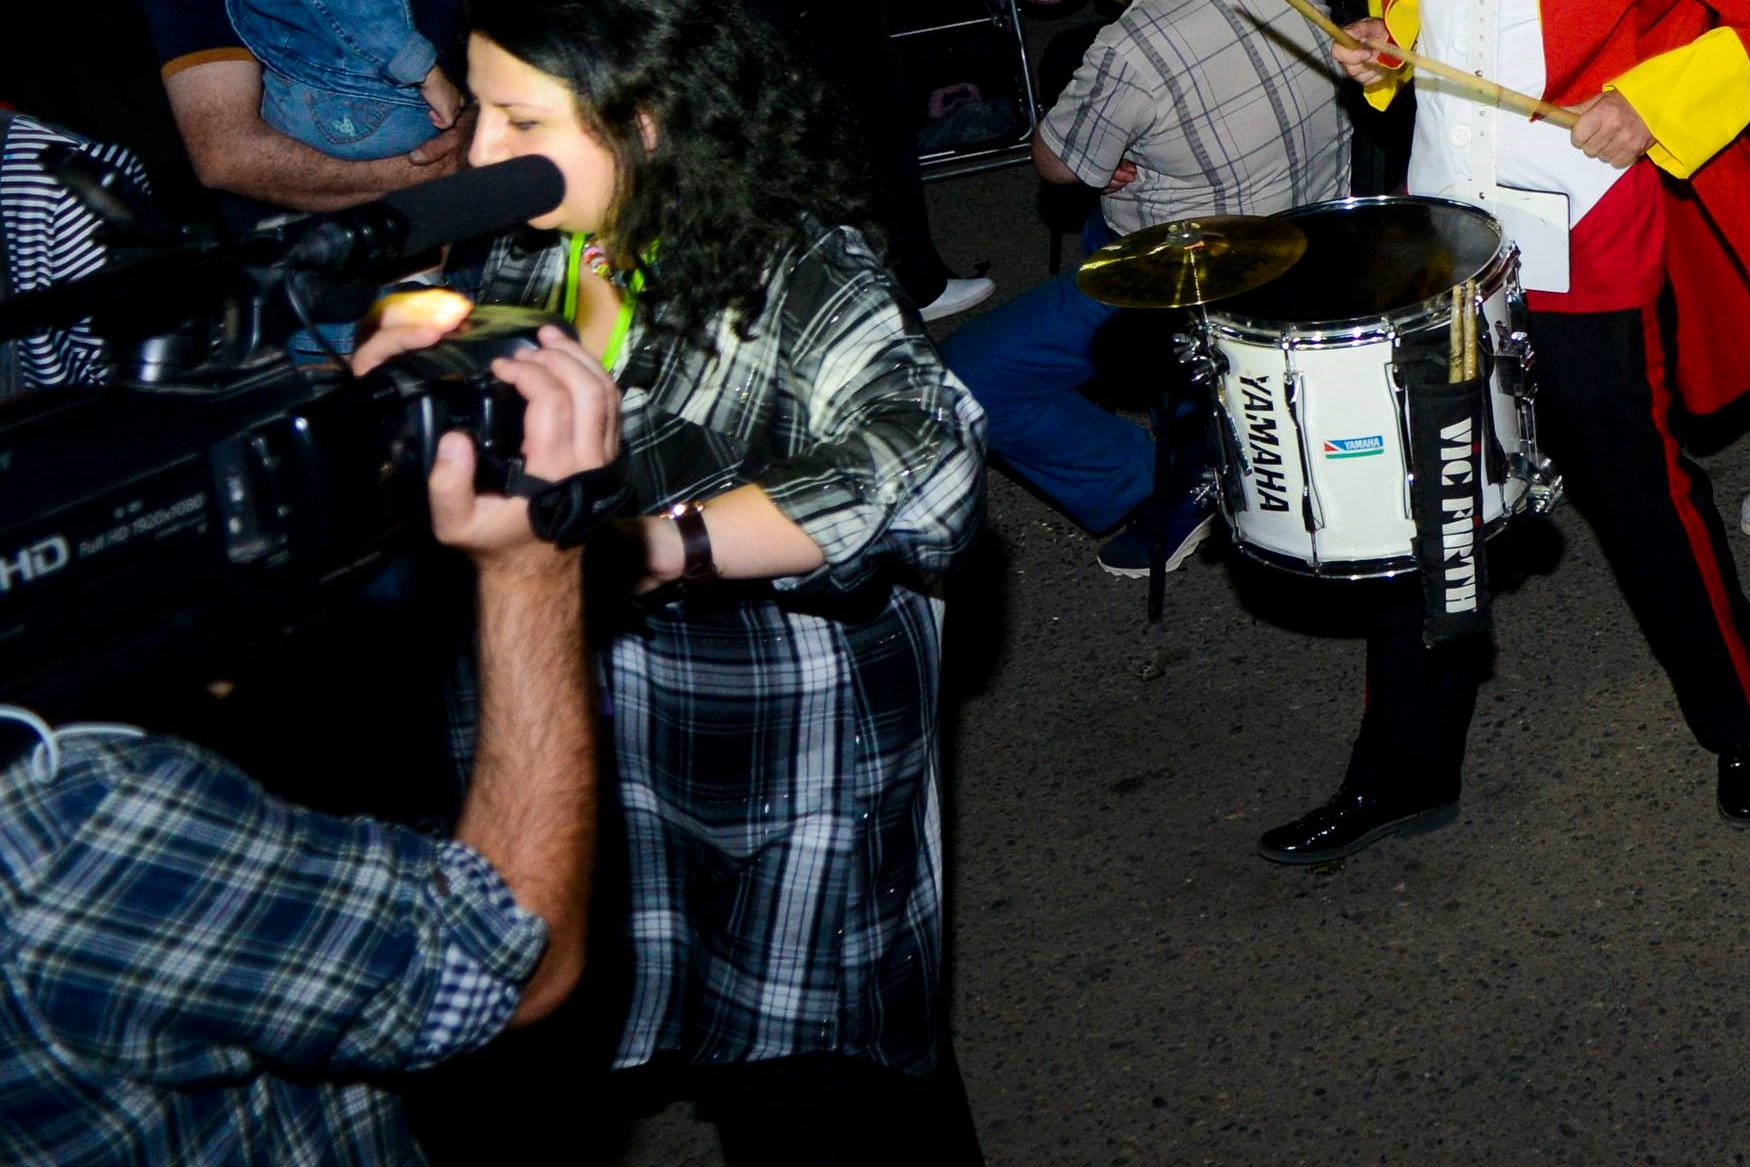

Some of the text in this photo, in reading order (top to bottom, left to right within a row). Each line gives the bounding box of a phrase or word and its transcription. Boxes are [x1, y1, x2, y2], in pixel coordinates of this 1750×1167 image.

[1239, 375, 1290, 512] YAMAHA
[1344, 437, 1380, 450] YAMAHA
[107, 524, 130, 545] HD
[1440, 417, 1477, 614] VIC FIRTH
